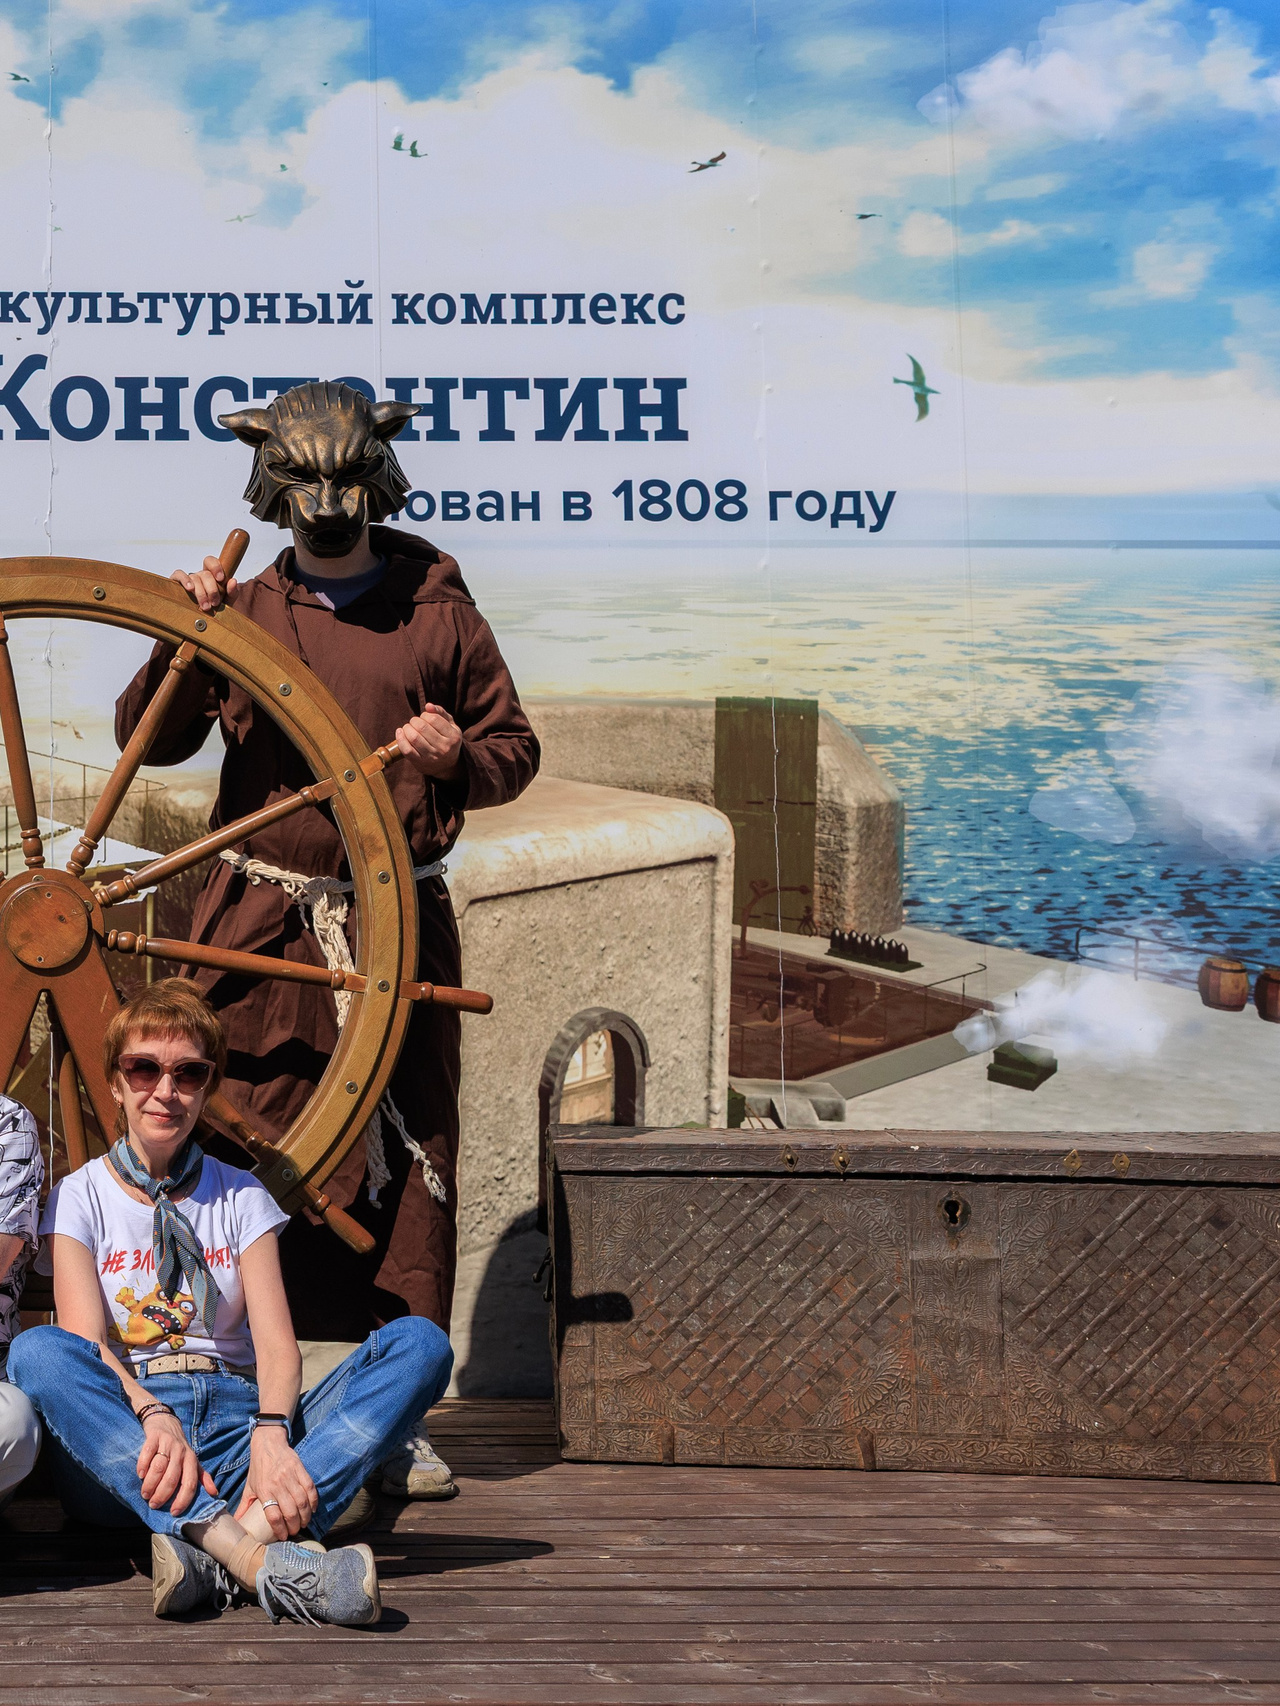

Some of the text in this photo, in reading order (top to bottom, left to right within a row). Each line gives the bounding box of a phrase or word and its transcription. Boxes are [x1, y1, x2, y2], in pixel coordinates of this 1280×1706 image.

[391, 292, 686, 325] комплекс
[390, 478, 897, 533] ован в 1808 году
[100, 1248, 128, 1277] НЕ
[201, 1241, 231, 1269] НЯ!
